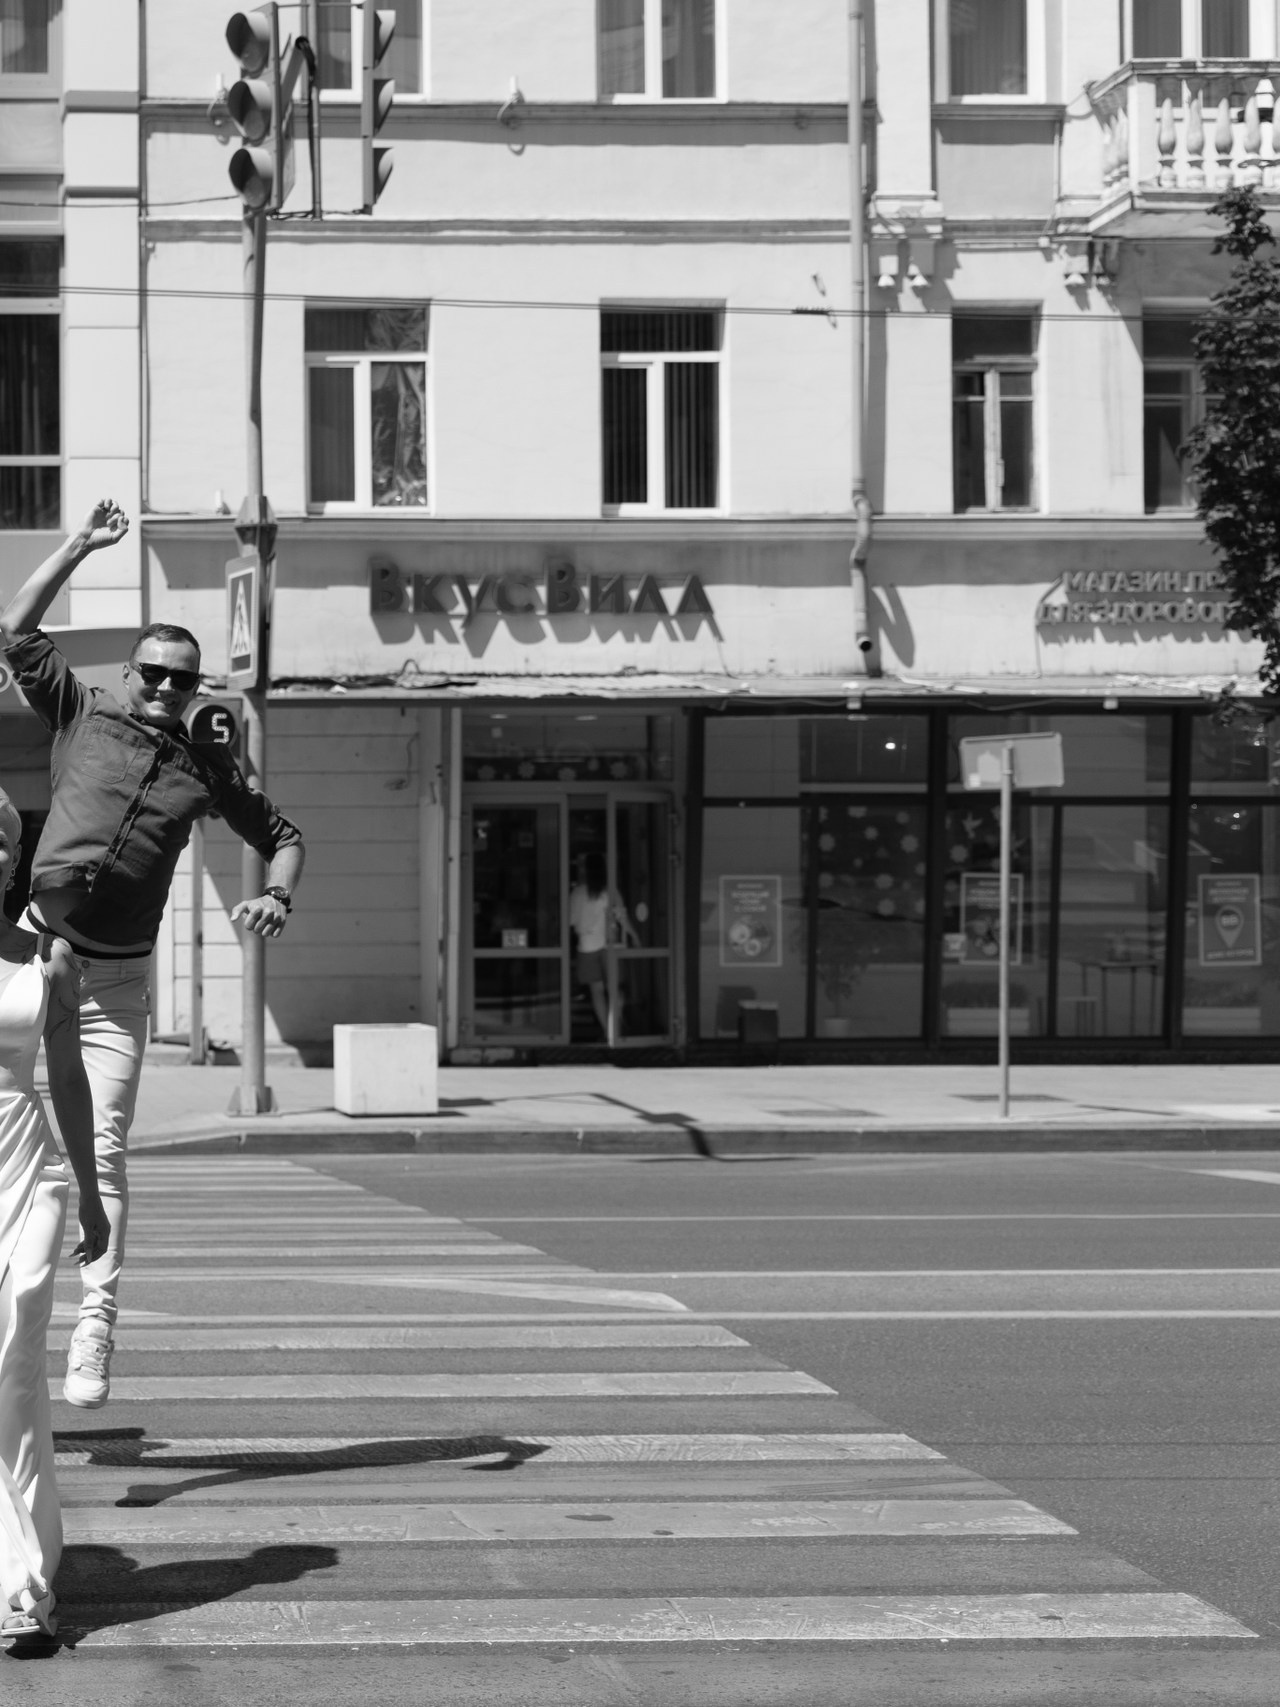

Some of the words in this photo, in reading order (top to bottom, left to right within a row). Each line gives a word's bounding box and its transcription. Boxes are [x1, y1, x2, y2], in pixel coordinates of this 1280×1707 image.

[1062, 570, 1181, 592] МАГАЗИН
[1036, 601, 1090, 625] ДЛЯ
[1095, 600, 1232, 625] ЗДОРОВОГ
[211, 713, 230, 744] 5
